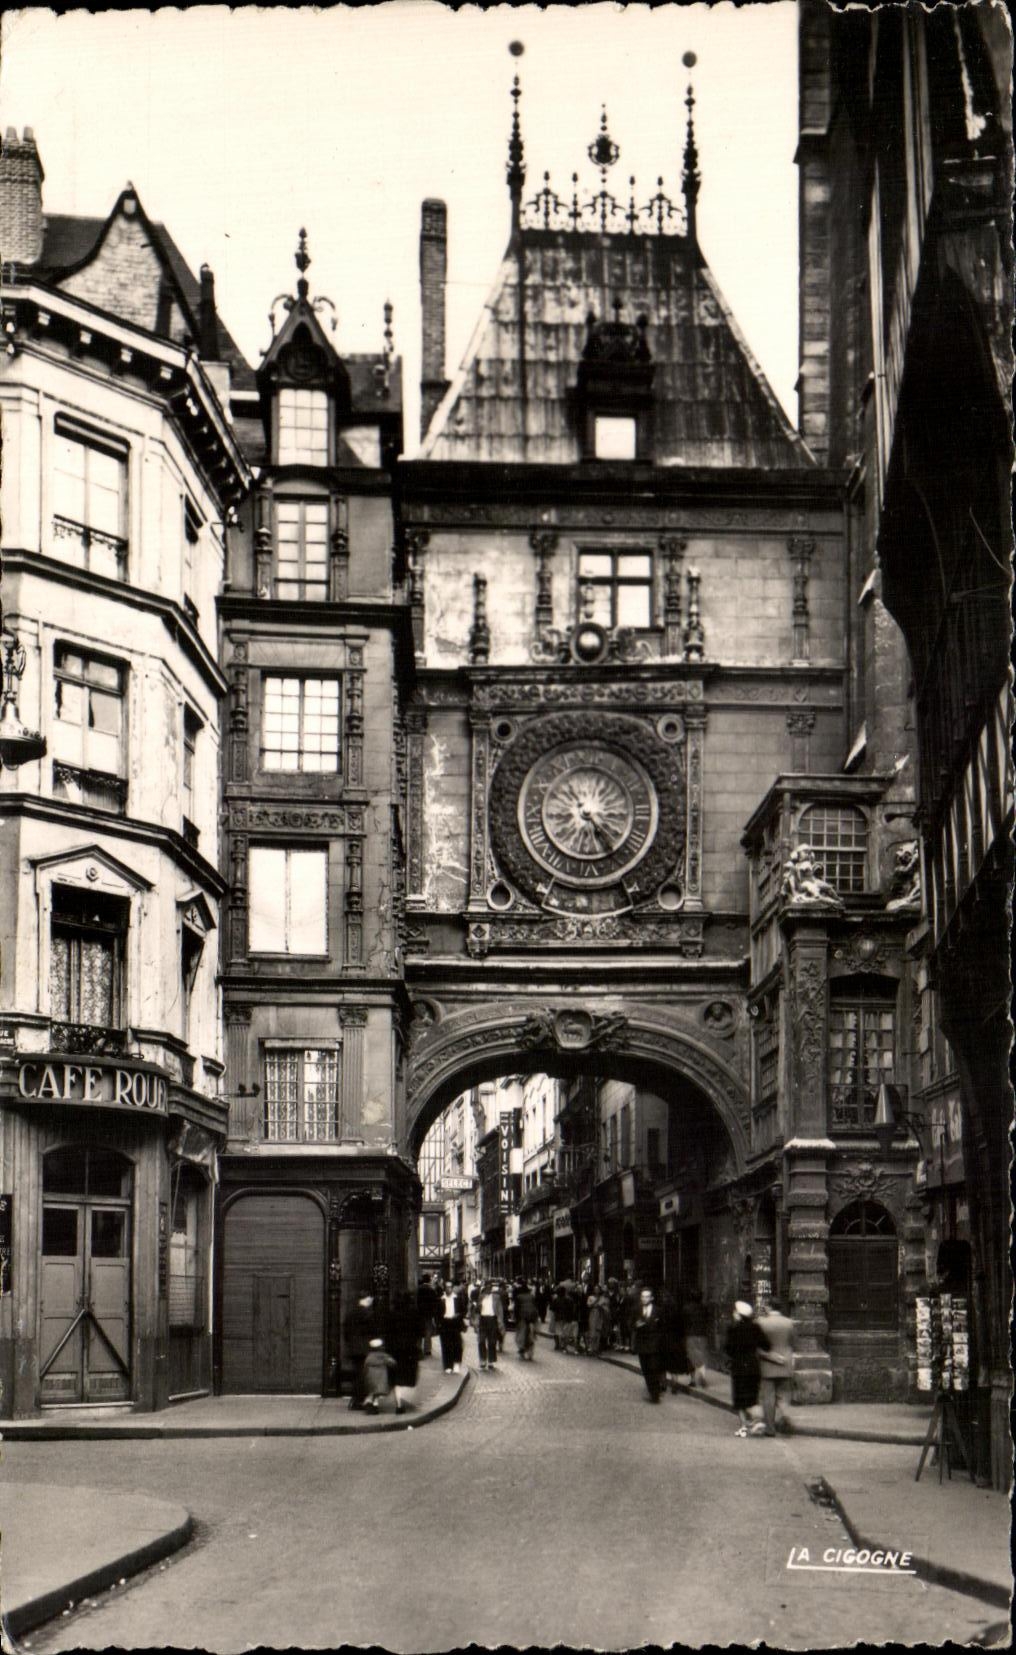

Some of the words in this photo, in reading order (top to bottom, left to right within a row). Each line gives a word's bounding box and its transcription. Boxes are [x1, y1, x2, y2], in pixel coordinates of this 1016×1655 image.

[19, 1063, 103, 1100] CAFE
[115, 1069, 167, 1112] ROUE
[500, 1125, 509, 1201] VOISIN
